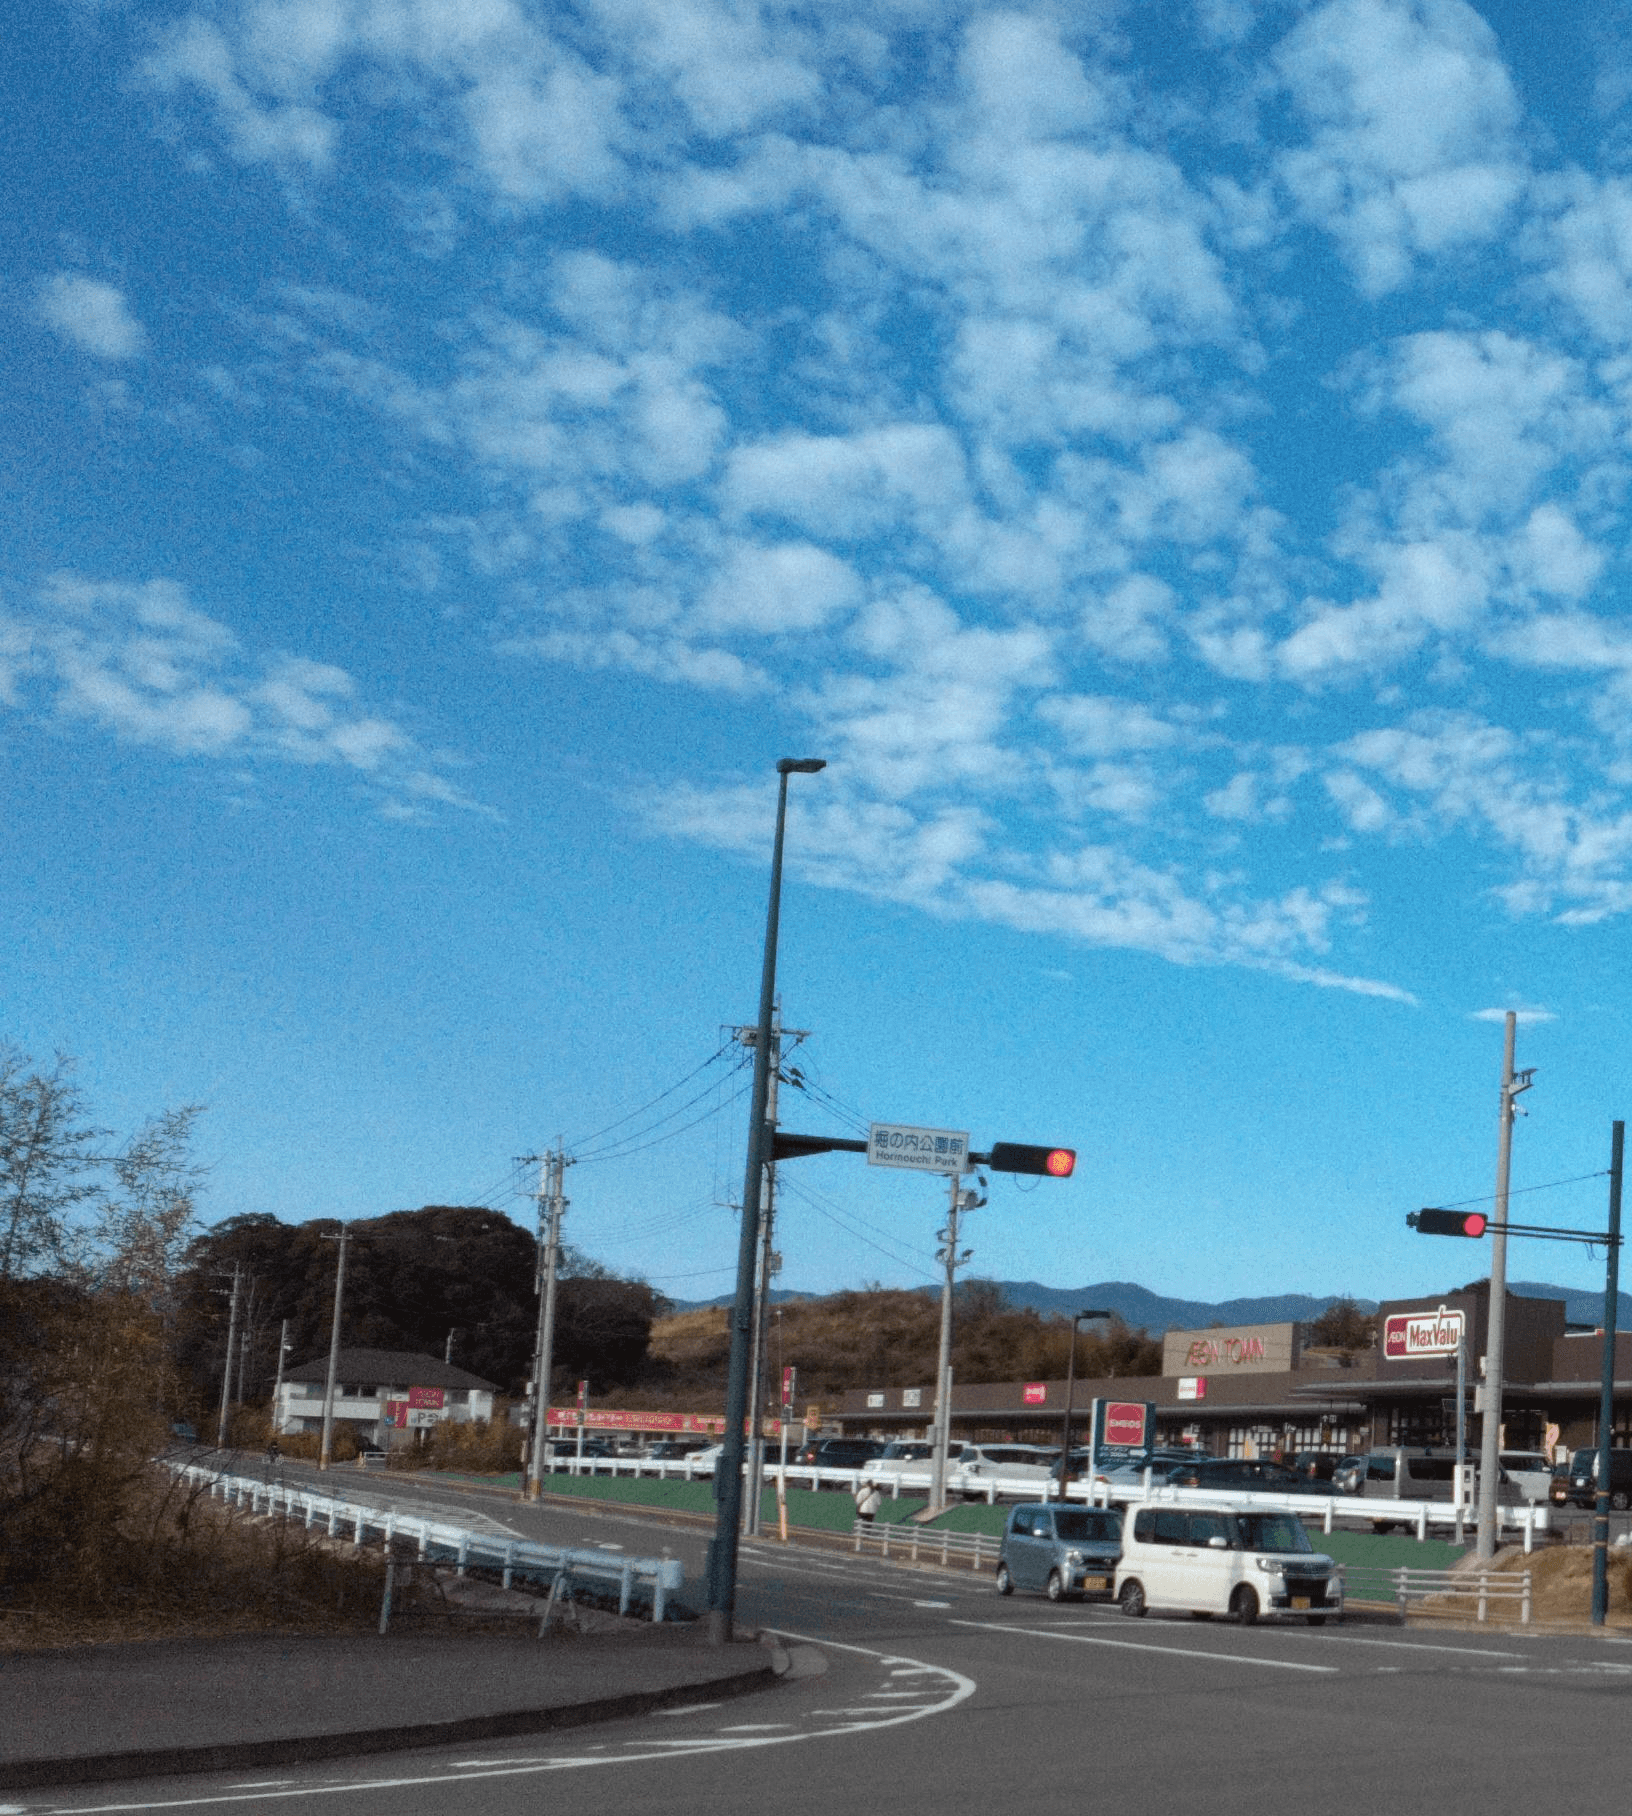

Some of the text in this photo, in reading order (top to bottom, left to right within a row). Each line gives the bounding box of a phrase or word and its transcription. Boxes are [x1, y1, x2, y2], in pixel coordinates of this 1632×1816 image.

[875, 1130, 963, 1155] 堀の内公園前
[934, 1155, 957, 1167] Park
[1409, 1305, 1458, 1348] MaxValu
[1223, 1335, 1267, 1365] TOWN
[1109, 1419, 1142, 1429] ENEOS
